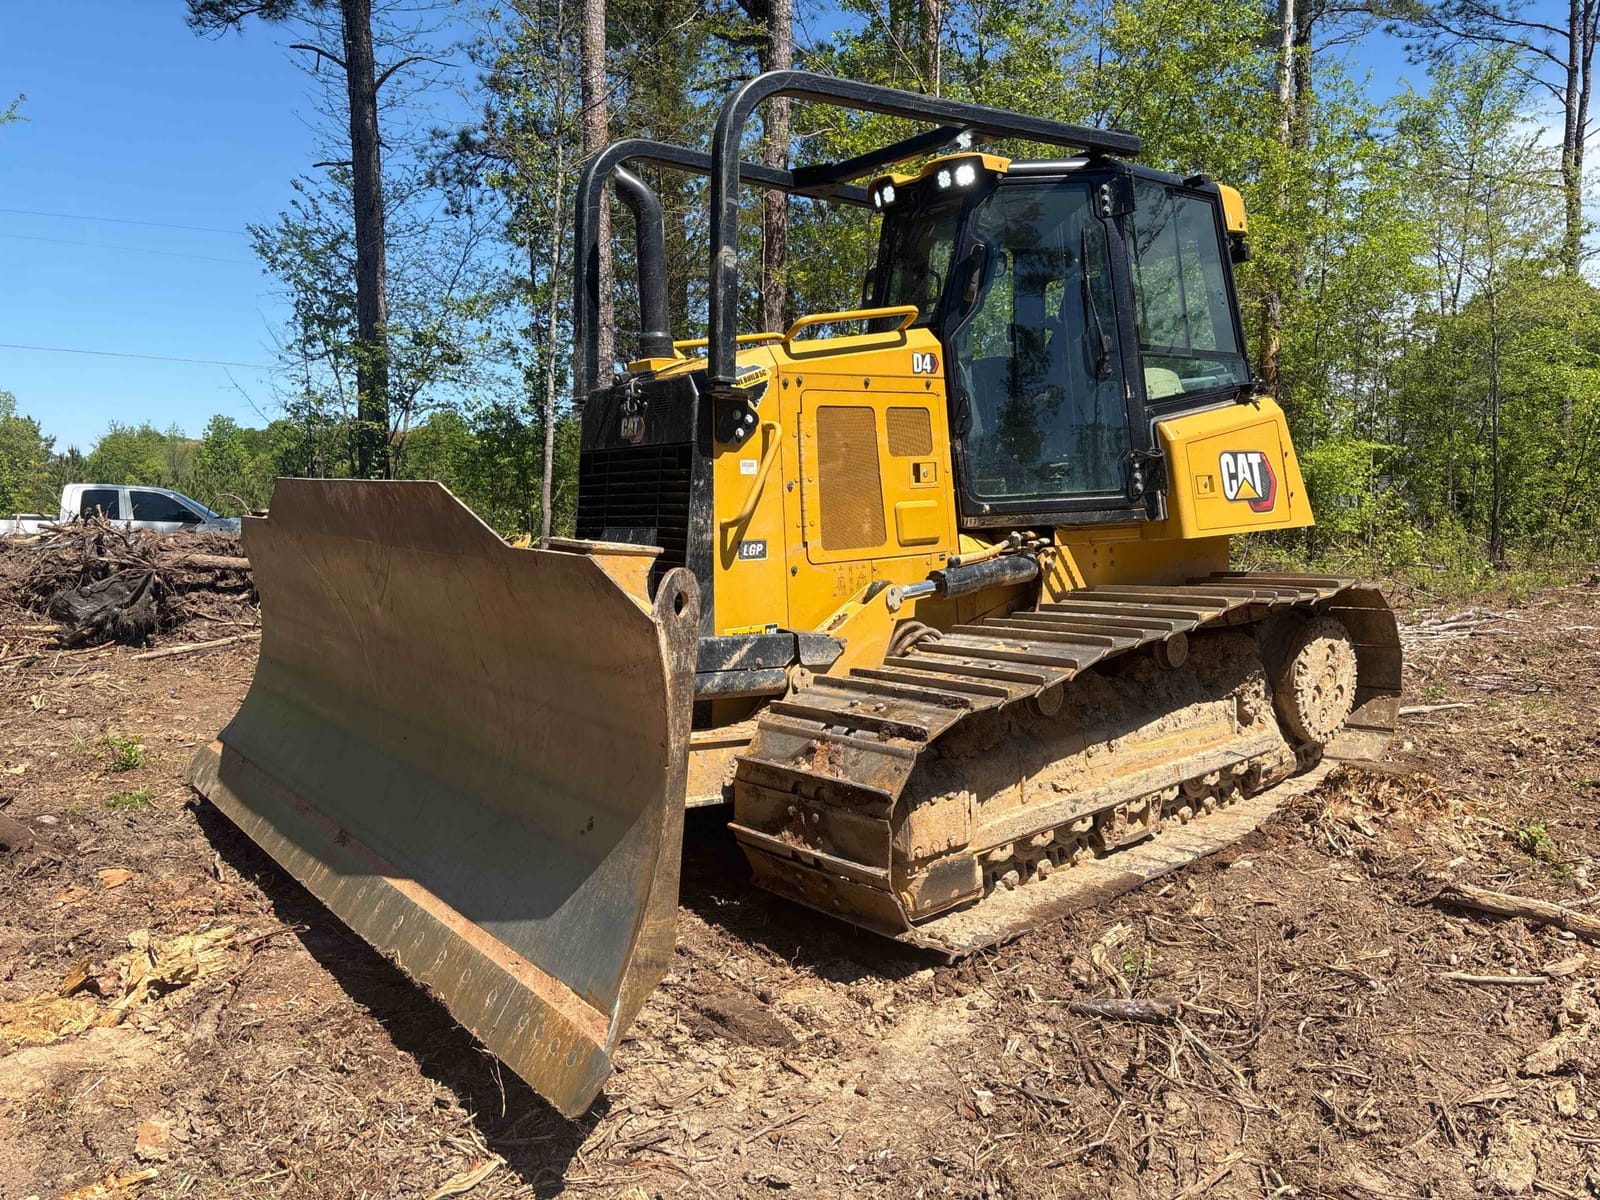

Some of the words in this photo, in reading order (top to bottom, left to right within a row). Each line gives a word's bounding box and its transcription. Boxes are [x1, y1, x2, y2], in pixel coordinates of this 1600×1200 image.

[912, 352, 932, 373] D4
[743, 371, 760, 384] BUILD
[621, 417, 640, 437] CAT
[1220, 452, 1263, 500] CAT
[743, 543, 764, 556] LGP
